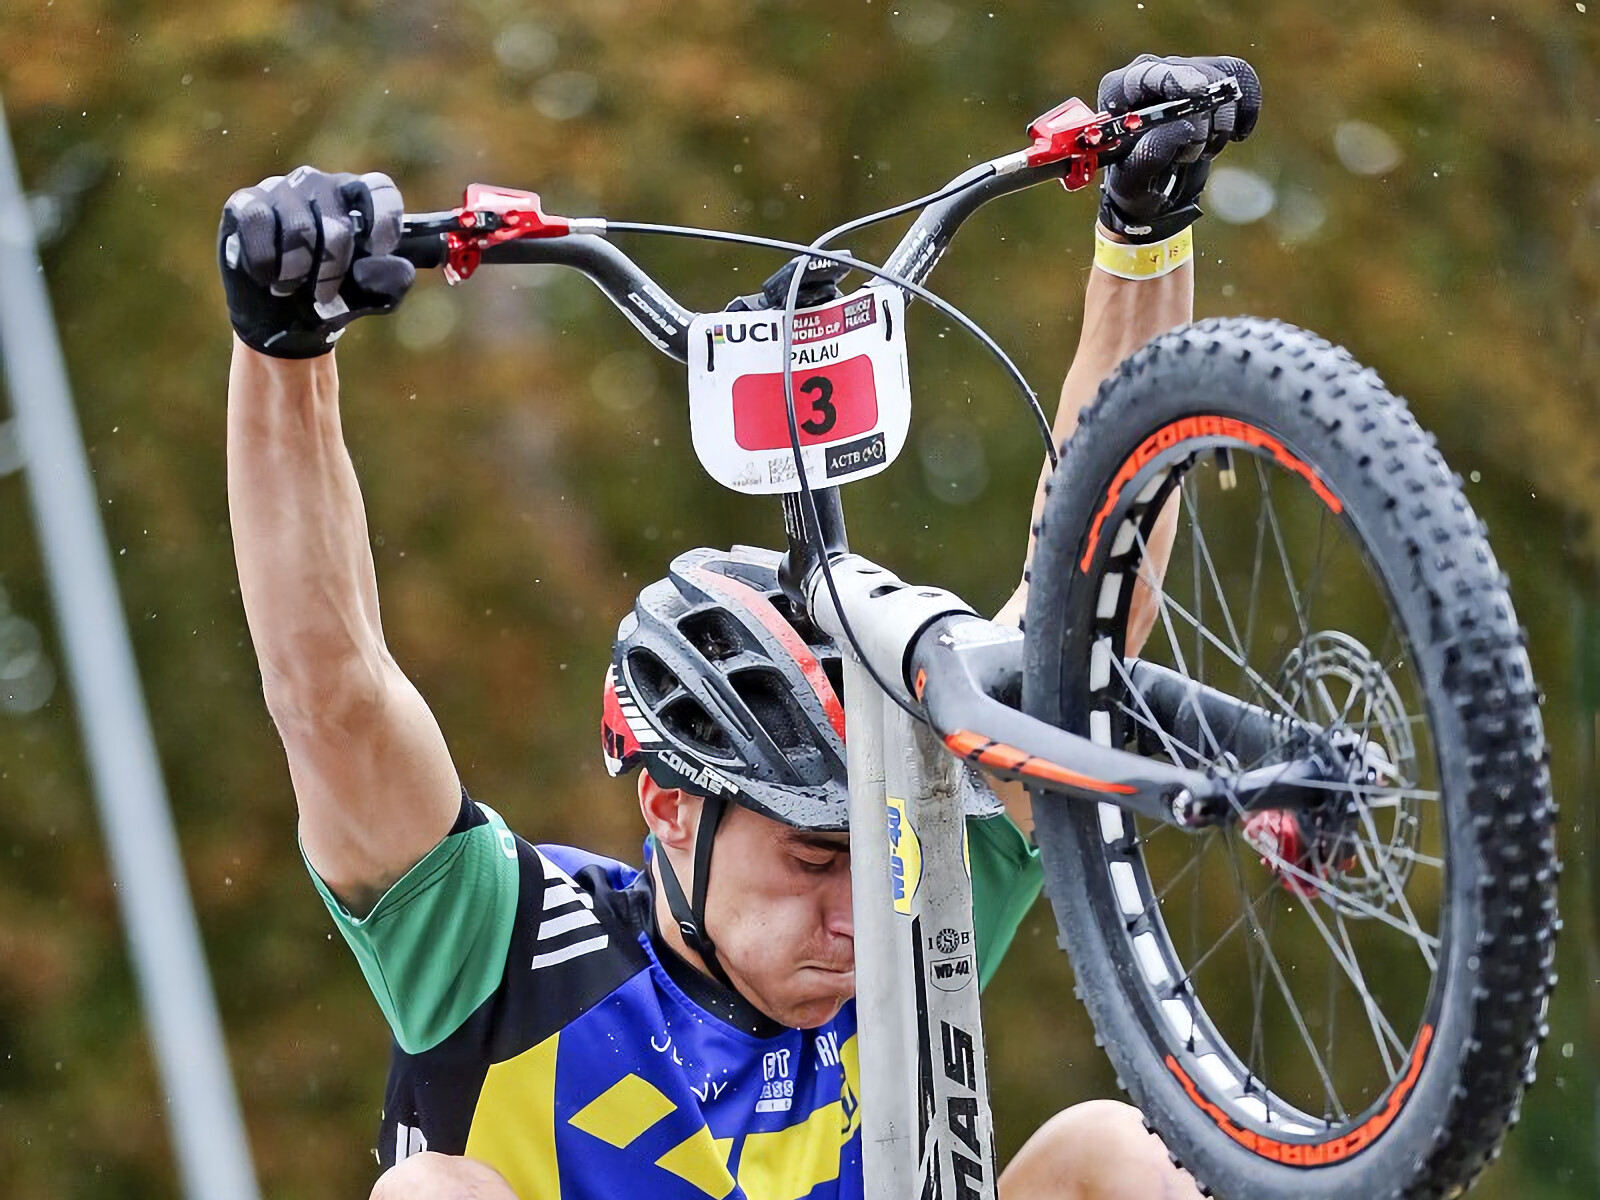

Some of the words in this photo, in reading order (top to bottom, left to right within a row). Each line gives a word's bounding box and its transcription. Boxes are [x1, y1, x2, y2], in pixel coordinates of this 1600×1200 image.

[725, 322, 779, 344] UCI
[800, 376, 837, 436] 3
[829, 452, 862, 471] ACTB
[657, 749, 723, 796] COMAS
[934, 960, 970, 980] WD-40
